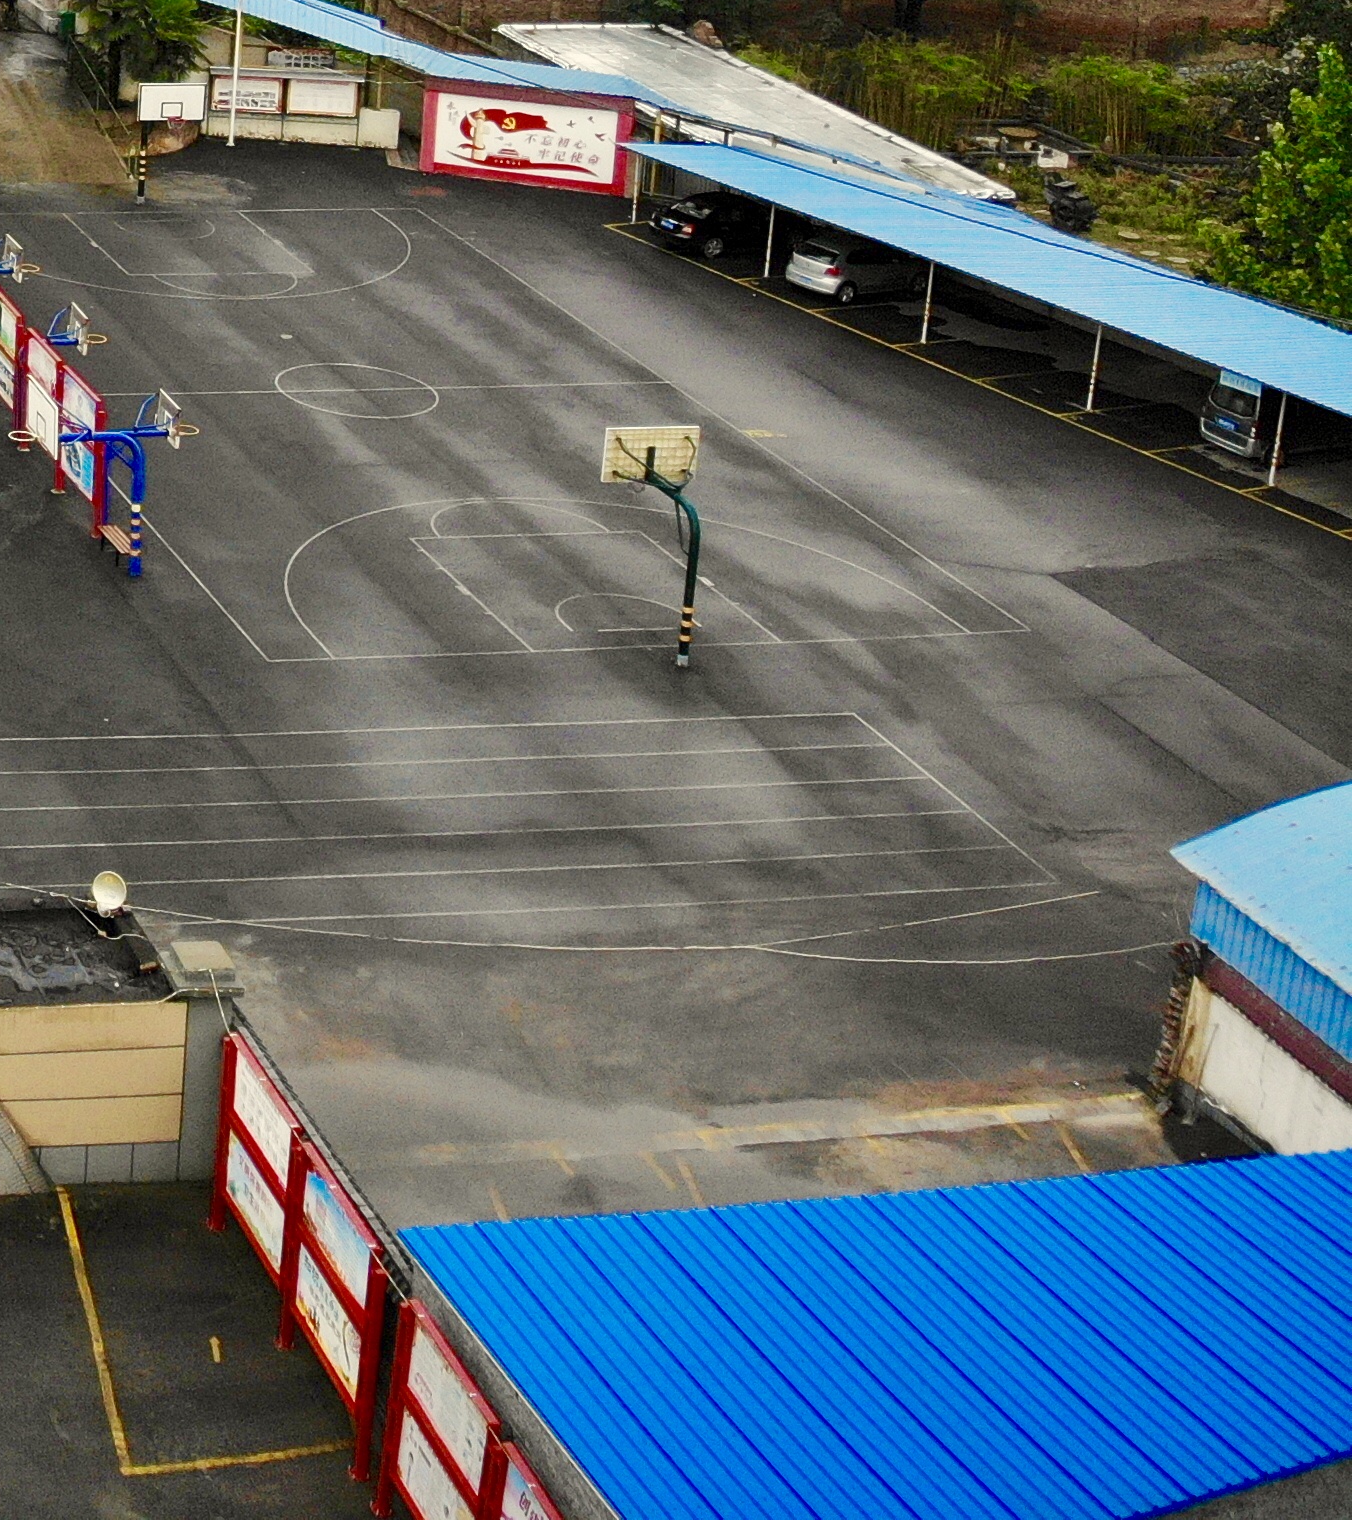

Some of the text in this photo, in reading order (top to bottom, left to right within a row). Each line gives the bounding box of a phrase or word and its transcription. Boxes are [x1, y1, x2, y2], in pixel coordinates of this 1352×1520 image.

[524, 133, 587, 150] 不忘初心
[538, 147, 602, 166] 牢记使命
